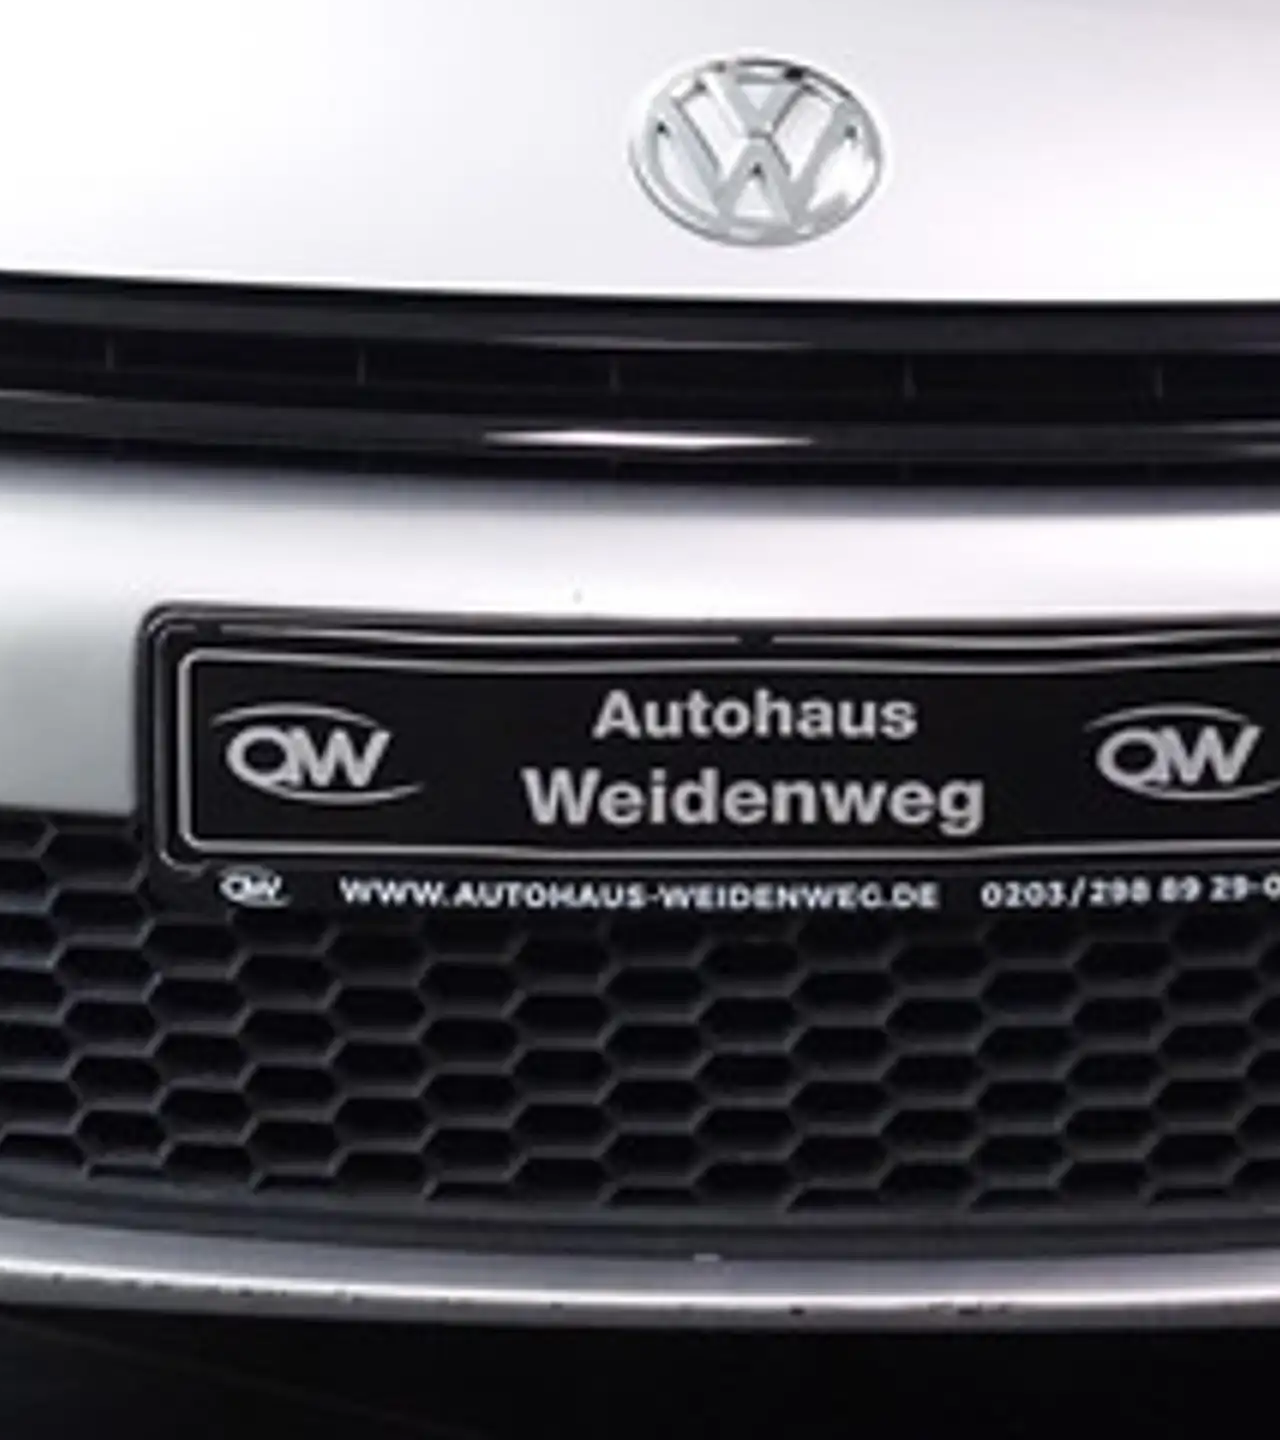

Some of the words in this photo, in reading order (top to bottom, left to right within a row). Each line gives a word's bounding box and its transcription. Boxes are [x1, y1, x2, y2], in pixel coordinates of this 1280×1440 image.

[632, 60, 882, 247] VW
[592, 688, 919, 740] Autohaus
[520, 766, 985, 837] Weidenweg
[338, 876, 939, 911] WWW.AUTOHAUS-WEIDENWEG.DE
